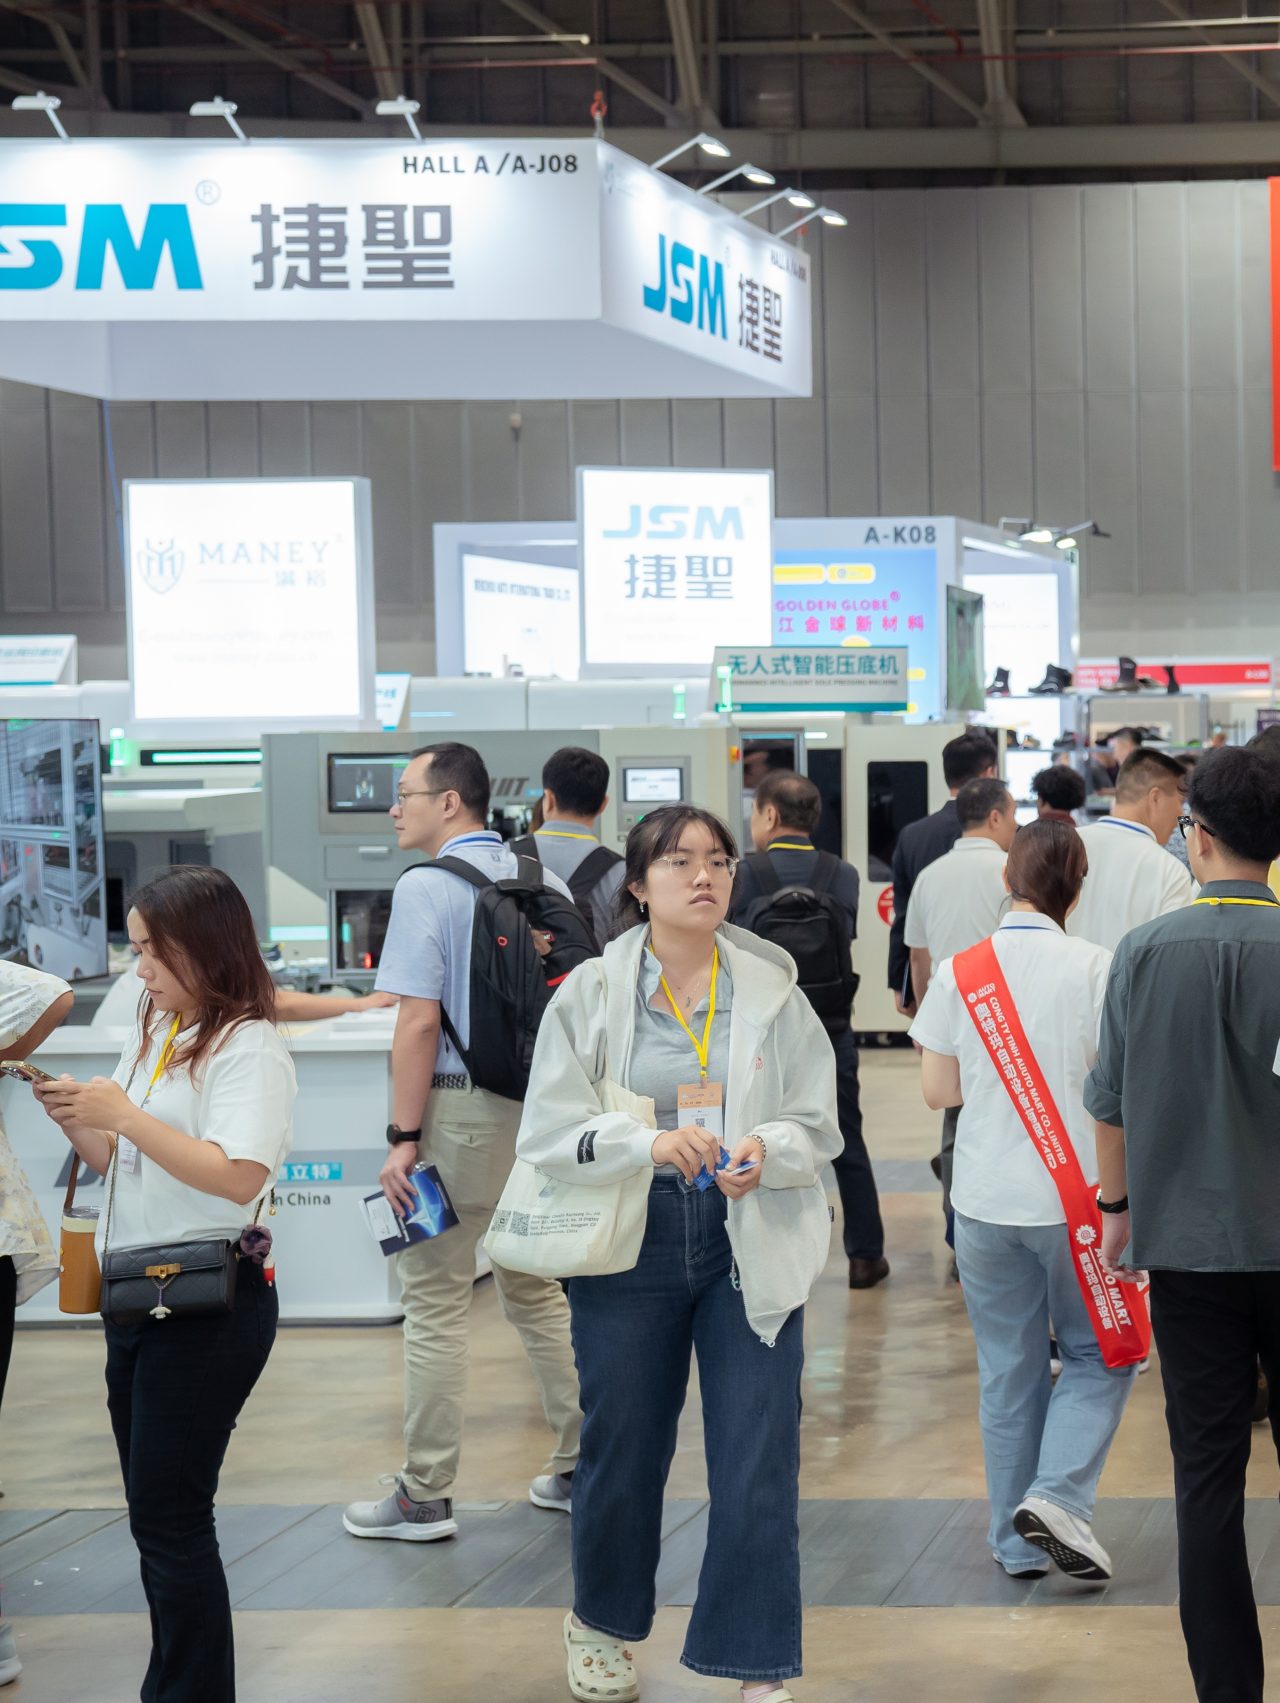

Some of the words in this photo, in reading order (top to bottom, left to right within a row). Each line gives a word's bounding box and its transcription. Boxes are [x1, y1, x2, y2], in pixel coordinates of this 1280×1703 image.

[403, 155, 463, 173] HALL
[473, 154, 490, 173] A
[251, 203, 456, 291] 捷聖
[643, 232, 728, 341] JSM
[738, 273, 783, 363] 捷聖
[602, 504, 744, 540] JSM
[864, 526, 937, 544] A-K08
[198, 540, 331, 565] MANEY
[624, 553, 734, 600] 捷聖
[775, 599, 837, 612] GOLDEN
[841, 598, 889, 611] GLOBE
[728, 654, 900, 676] 无人式智能压底机
[989, 996, 1004, 1022] CONG
[1000, 1022, 1011, 1036] TY
[1006, 1033, 1021, 1058] TINH
[1015, 1058, 1035, 1090] AUUTO
[1029, 1085, 1046, 1116] MART
[287, 1192, 331, 1206] China
[1108, 1287, 1132, 1326] MART
